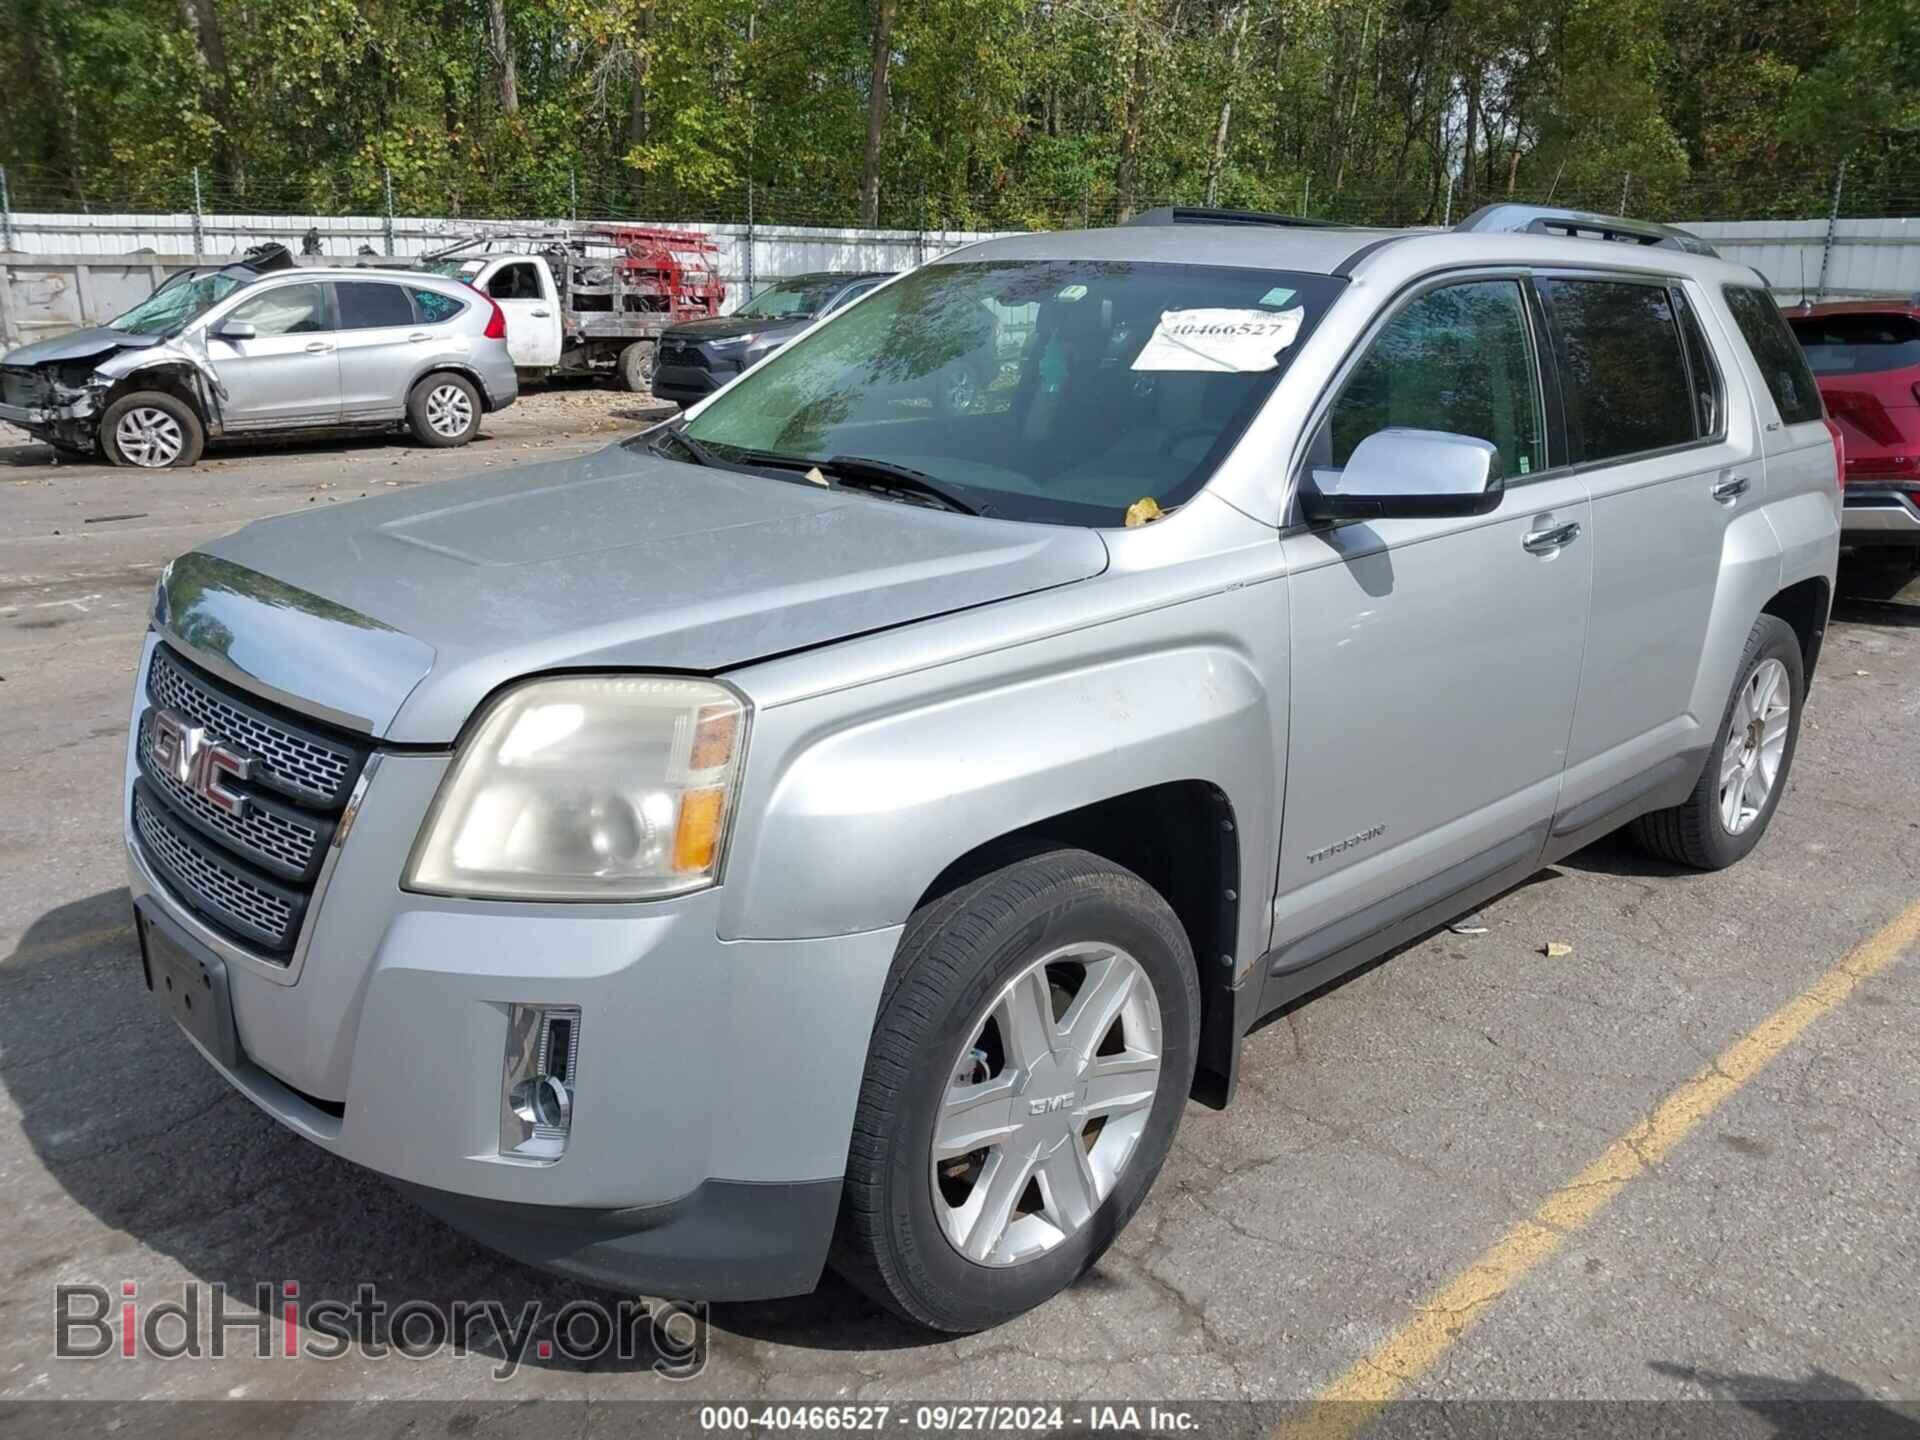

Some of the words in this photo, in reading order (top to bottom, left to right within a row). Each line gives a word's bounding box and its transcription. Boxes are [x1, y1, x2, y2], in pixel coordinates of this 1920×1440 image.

[1172, 322, 1283, 336] 40466527
[152, 709, 250, 819] GMC
[1029, 1091, 1076, 1116] GMC
